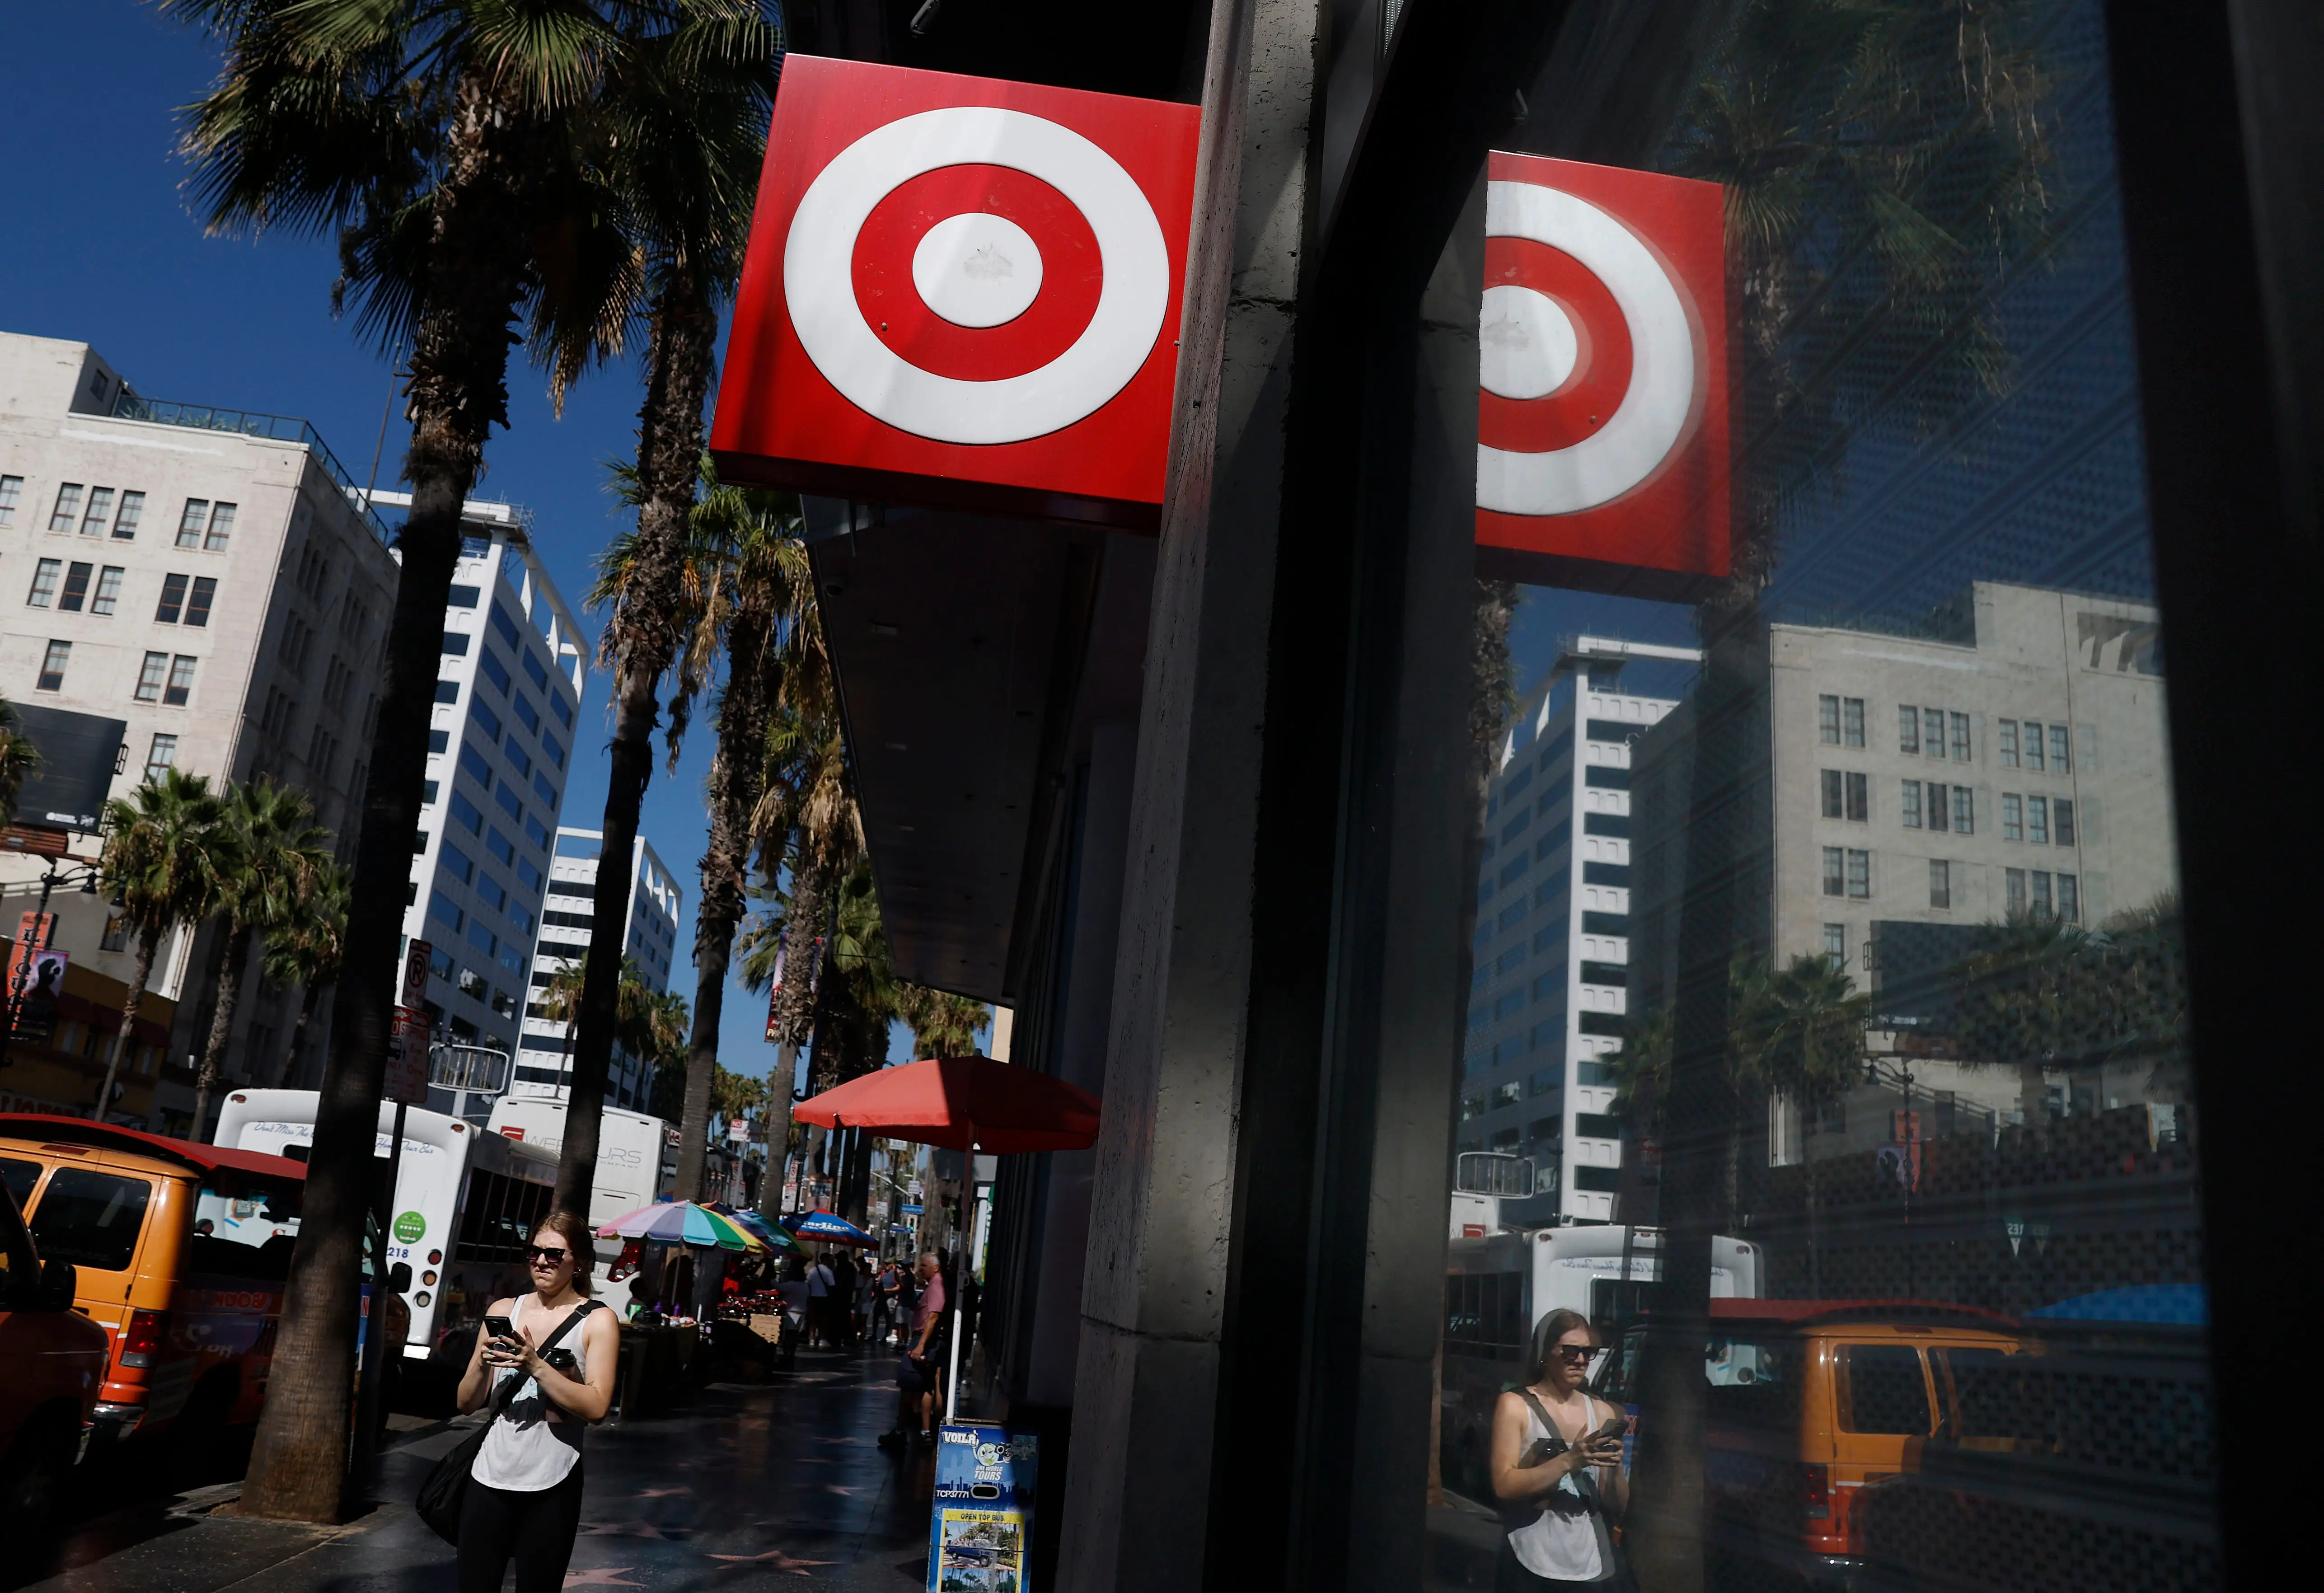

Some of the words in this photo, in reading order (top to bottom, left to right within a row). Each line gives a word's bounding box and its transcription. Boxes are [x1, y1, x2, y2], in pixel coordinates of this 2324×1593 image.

[296, 1126, 309, 1137] The
[418, 1143, 433, 1154] Bus
[600, 1161, 638, 1170] OMPANY
[942, 1431, 977, 1445] VOILA
[974, 1471, 1002, 1481] TOURS
[937, 1490, 970, 1499] TCP37771
